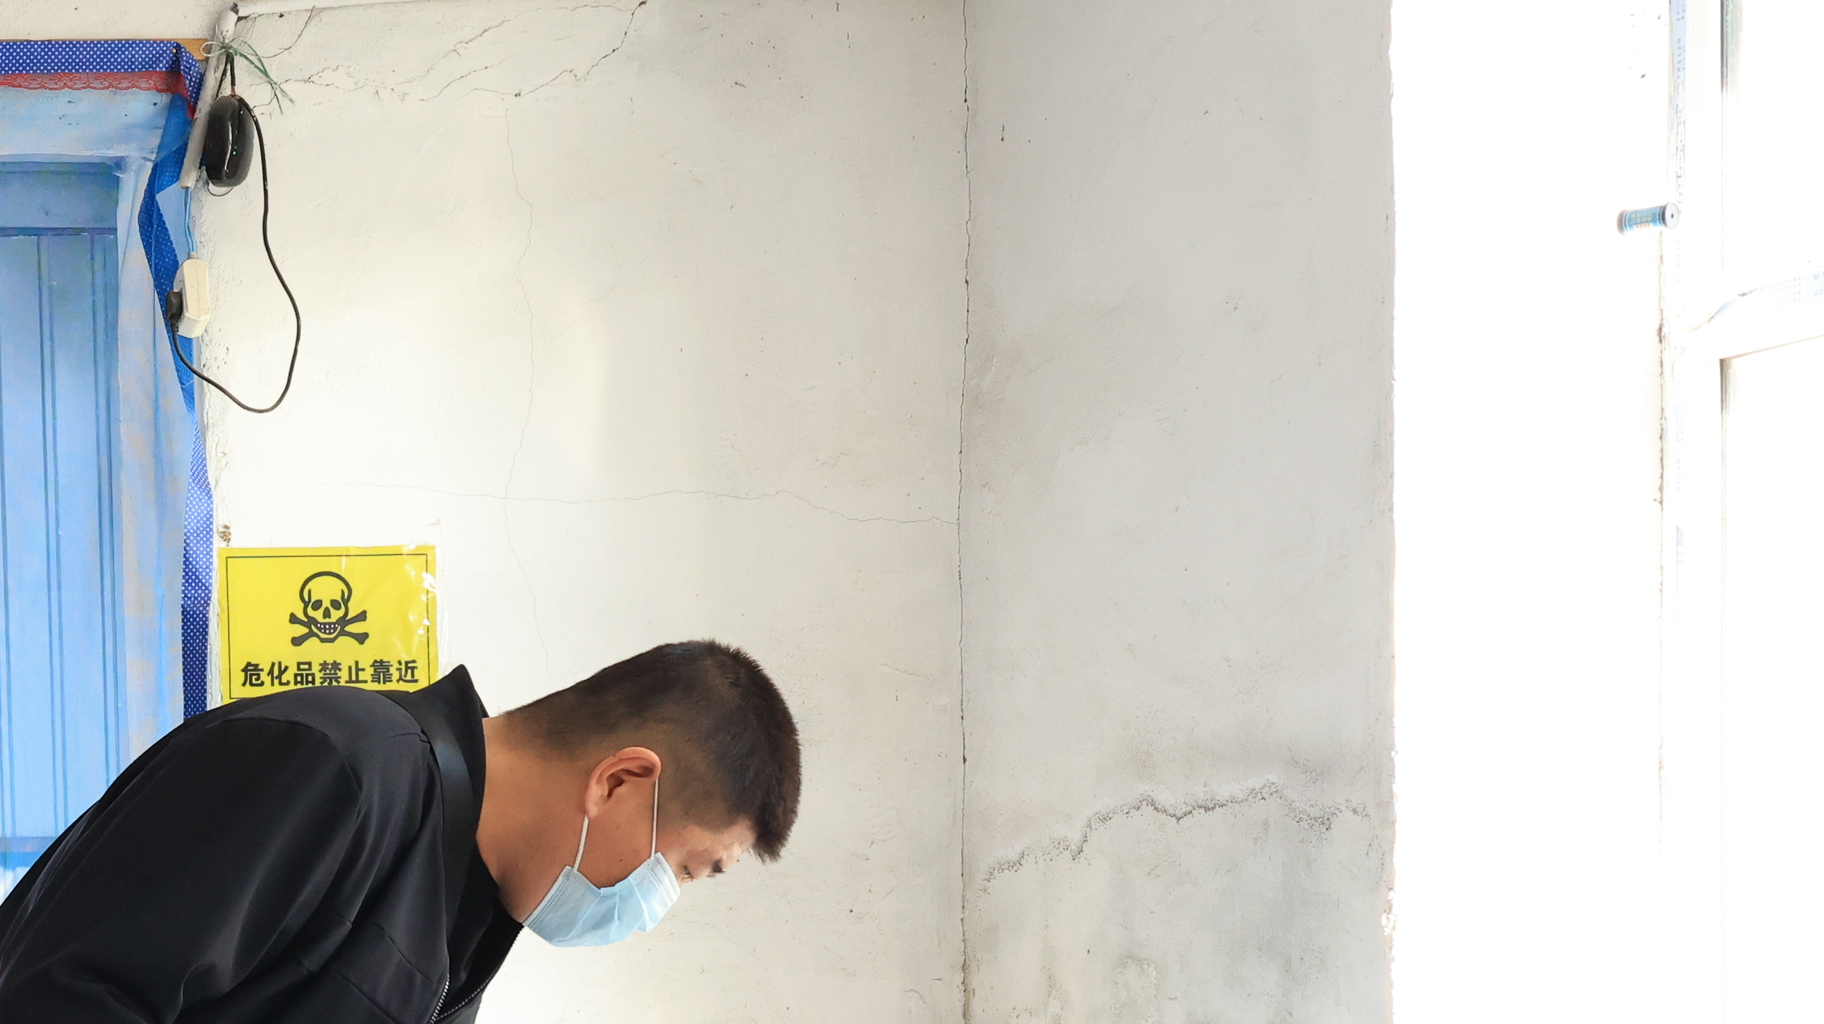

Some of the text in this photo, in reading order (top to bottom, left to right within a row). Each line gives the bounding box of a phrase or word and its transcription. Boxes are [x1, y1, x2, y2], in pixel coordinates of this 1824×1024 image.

[241, 659, 419, 687] 危化品禁止靠近
